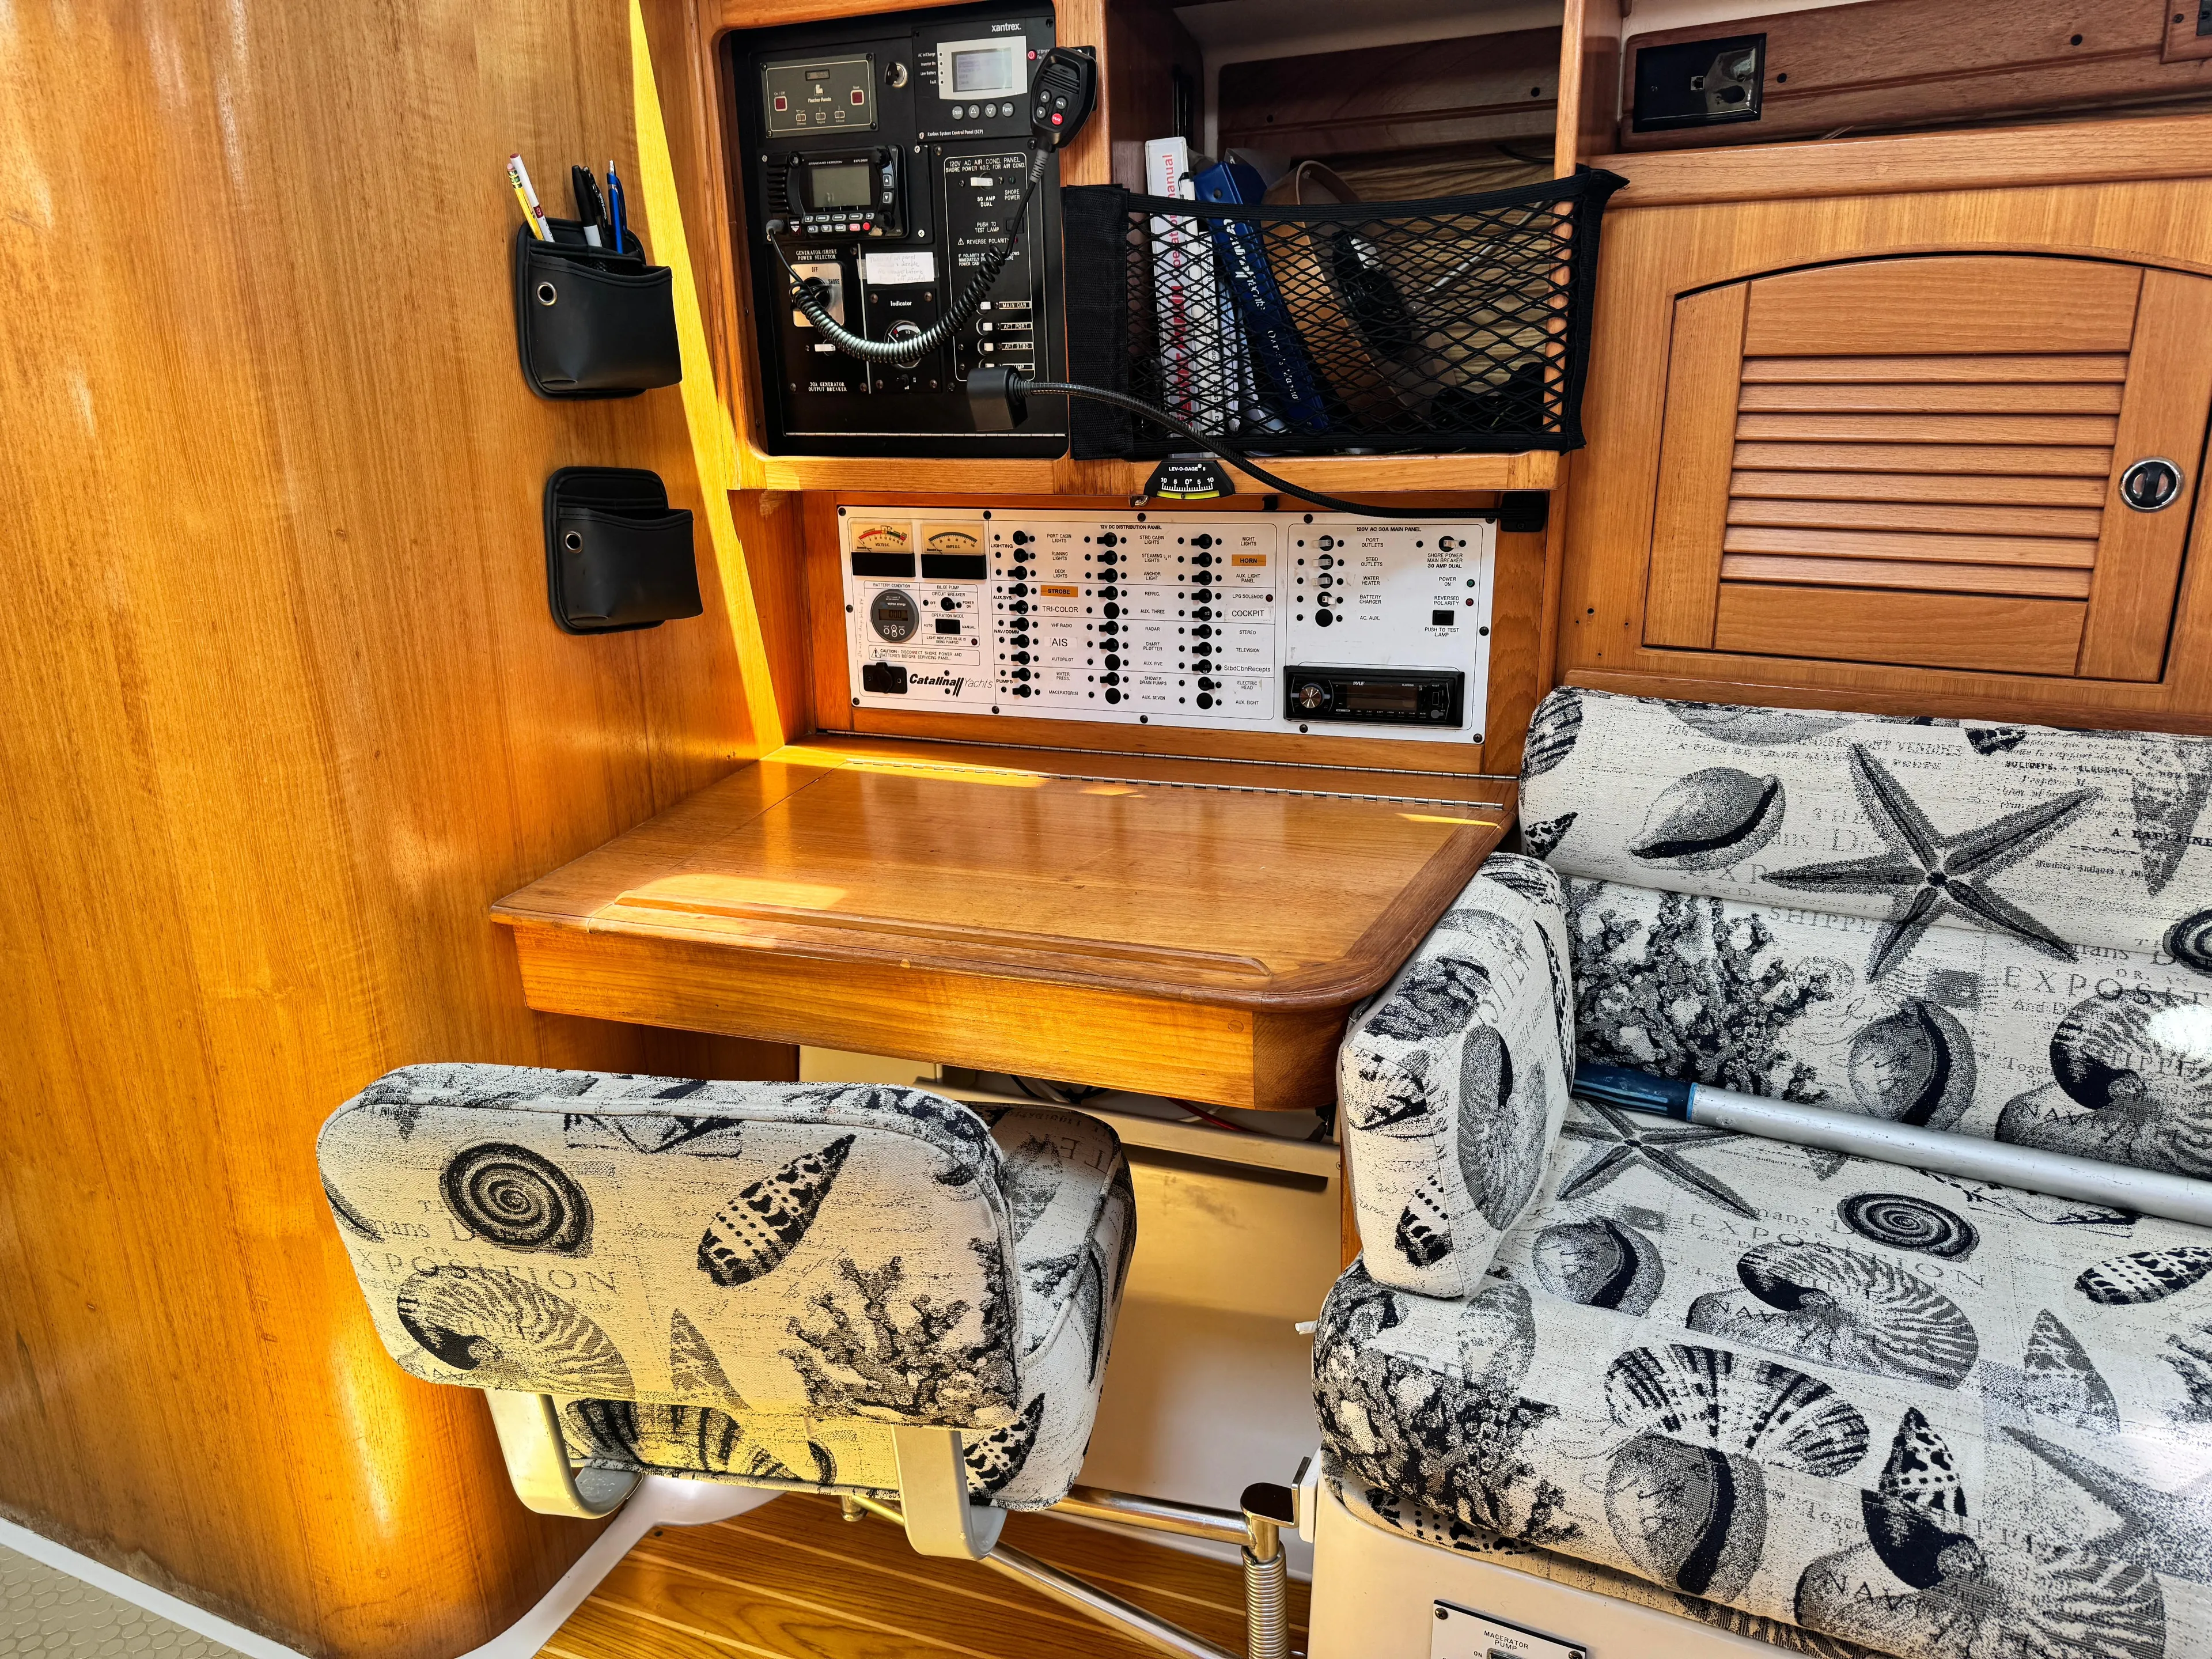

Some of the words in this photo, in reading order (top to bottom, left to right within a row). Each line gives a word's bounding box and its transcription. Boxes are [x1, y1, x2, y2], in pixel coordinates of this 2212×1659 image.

[1052, 638, 1068, 647] AIS
[964, 678, 993, 688] Yachts
[1484, 1630, 1529, 1649] MACERATOR
[1494, 1640, 1517, 1650] PUMP
